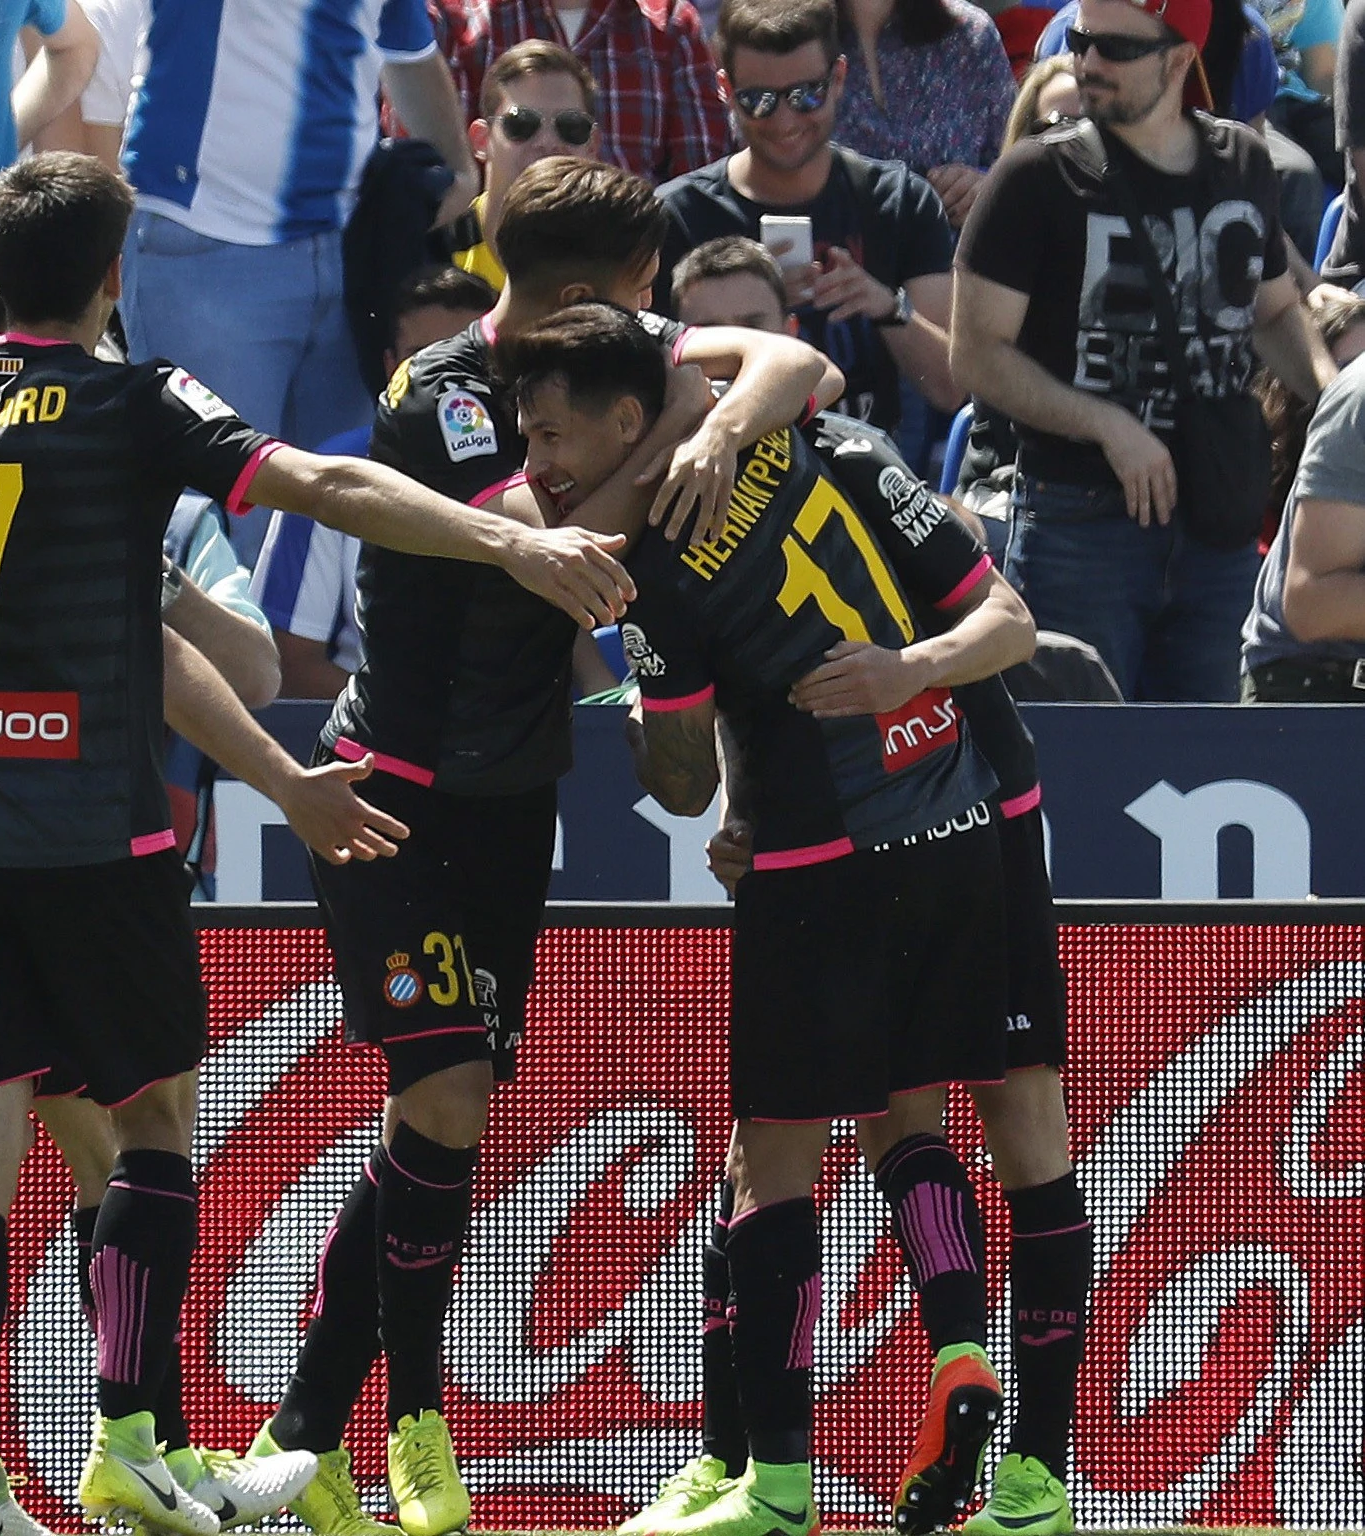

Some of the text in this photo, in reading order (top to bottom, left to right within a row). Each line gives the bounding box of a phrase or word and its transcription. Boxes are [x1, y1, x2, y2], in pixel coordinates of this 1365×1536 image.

[451, 435, 492, 451] LaLiga
[776, 474, 915, 645] 17
[423, 931, 476, 1006] 31
